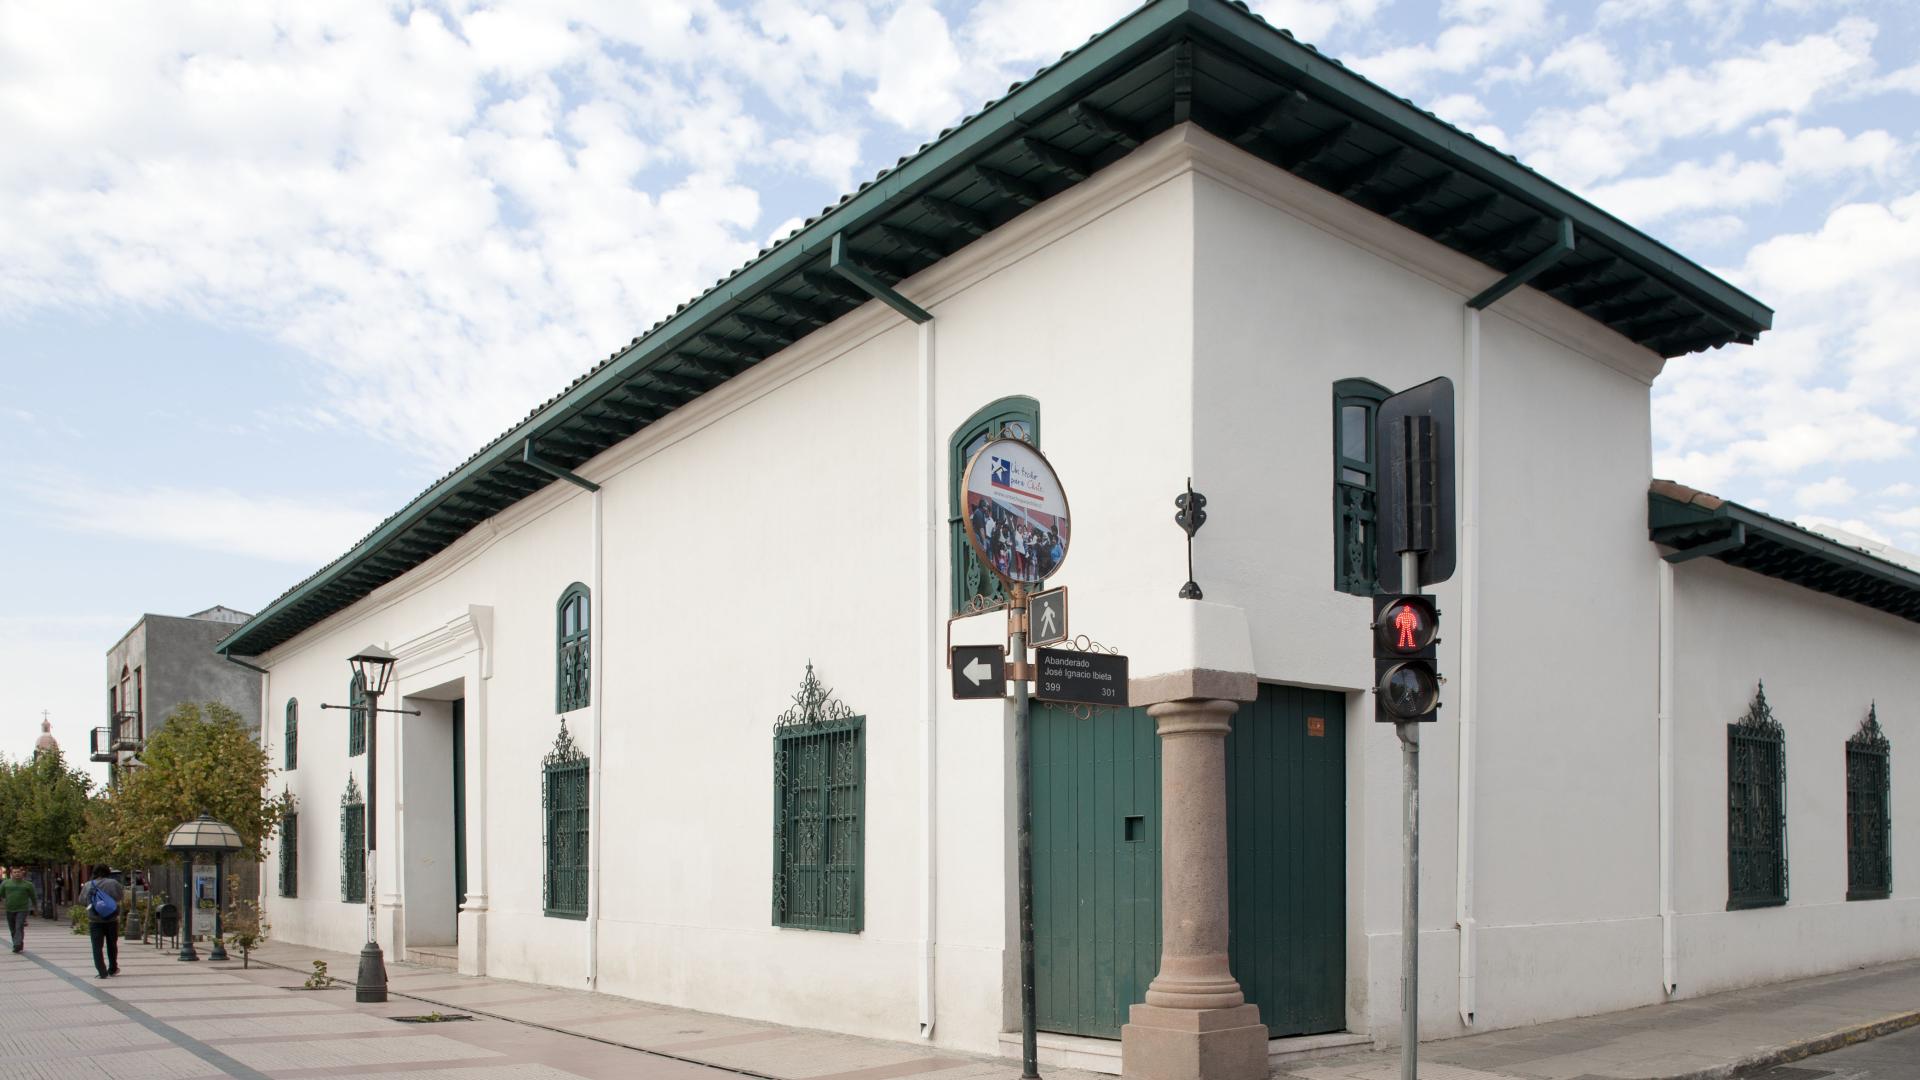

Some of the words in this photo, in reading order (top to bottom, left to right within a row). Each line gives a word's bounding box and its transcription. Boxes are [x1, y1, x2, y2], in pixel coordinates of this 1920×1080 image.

[1045, 656, 1090, 668] Abanderado
[1045, 667, 1063, 676] José
[1065, 669, 1091, 679] Ignacio
[1093, 671, 1112, 681] Ibieta
[1045, 682, 1061, 691] 399
[1101, 688, 1116, 697] 301
